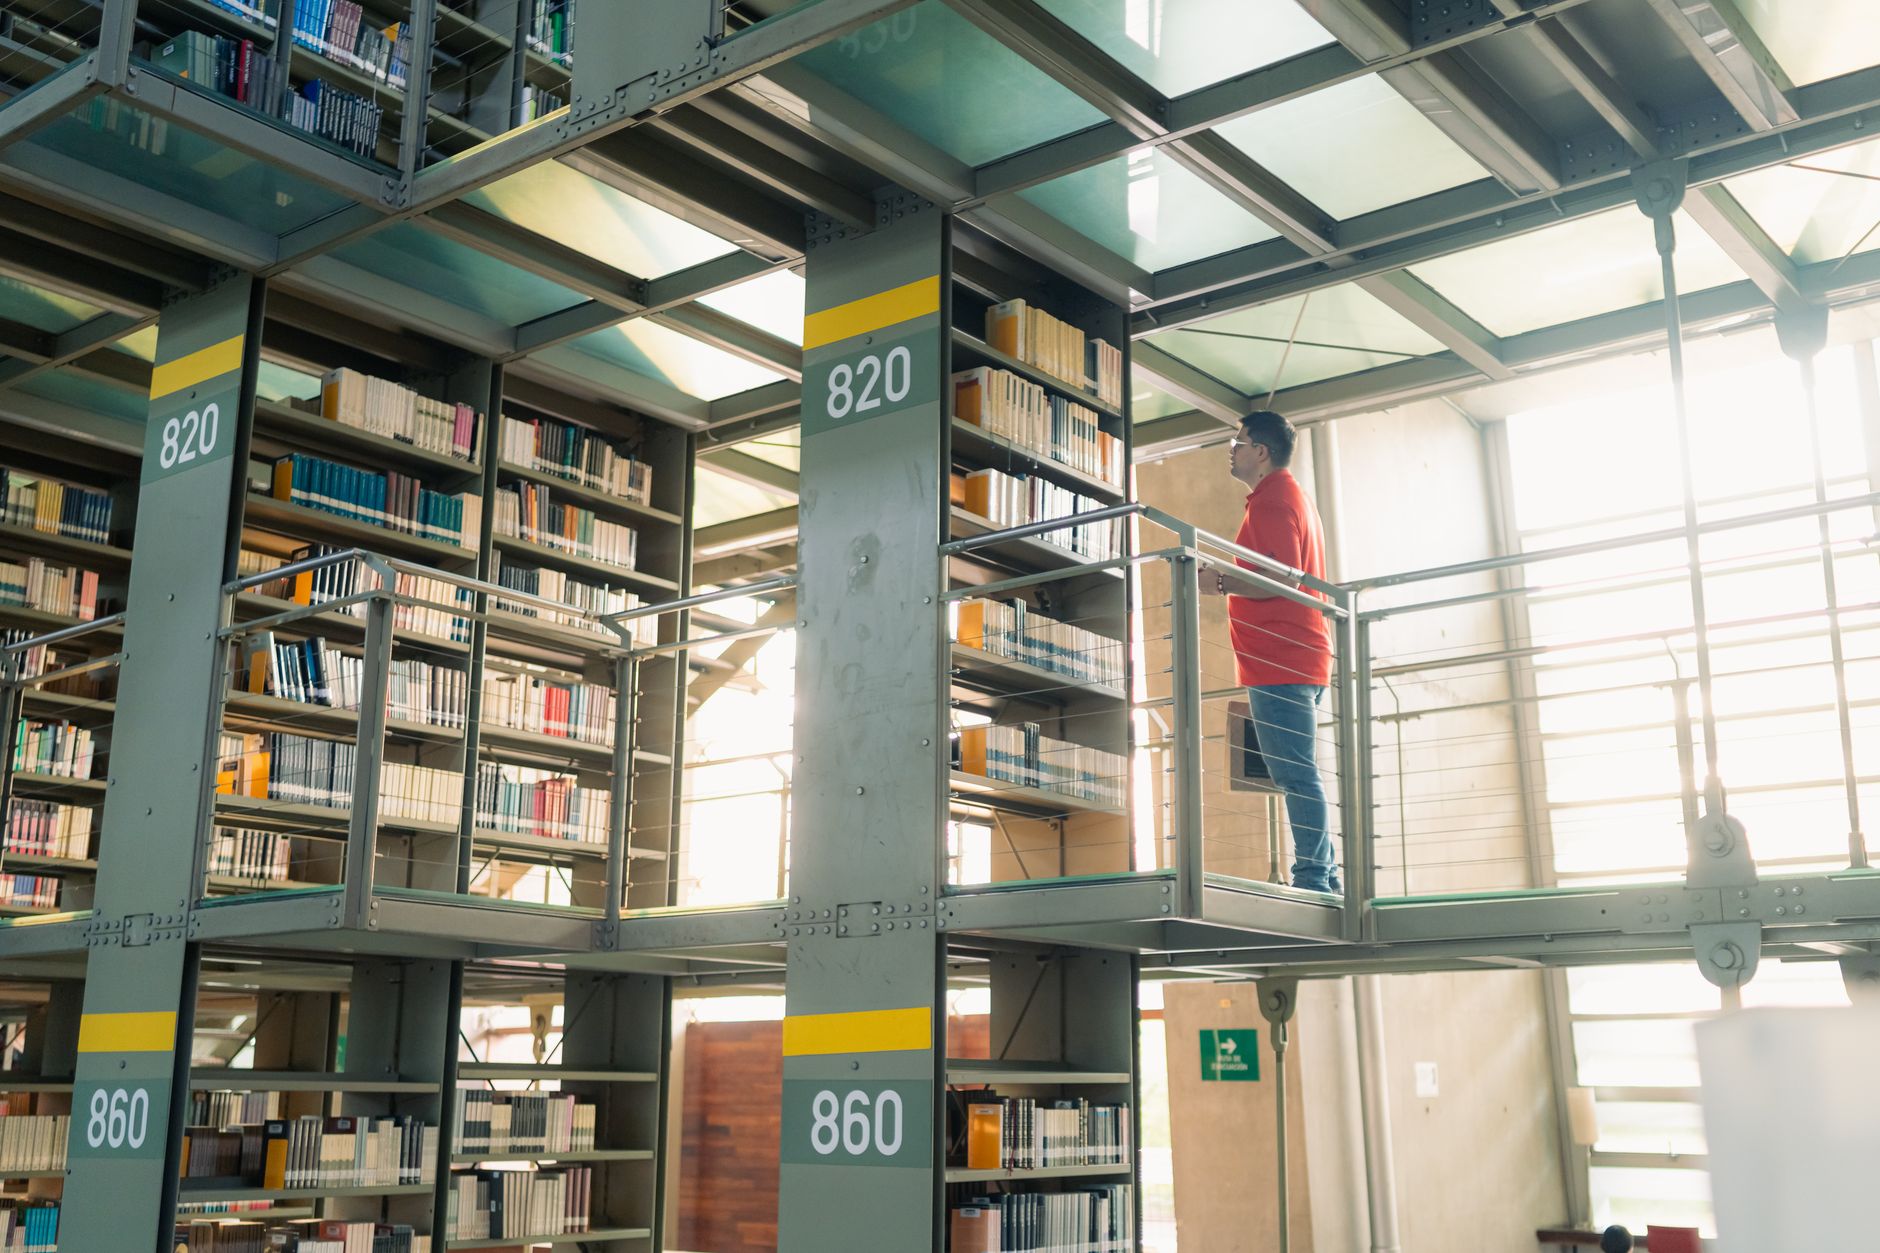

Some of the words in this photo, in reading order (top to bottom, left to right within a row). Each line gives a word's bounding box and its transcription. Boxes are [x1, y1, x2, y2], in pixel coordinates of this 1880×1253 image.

[827, 346, 911, 419] 820
[159, 402, 219, 469] 820
[87, 1088, 149, 1149] 860
[810, 1089, 903, 1156] 860
